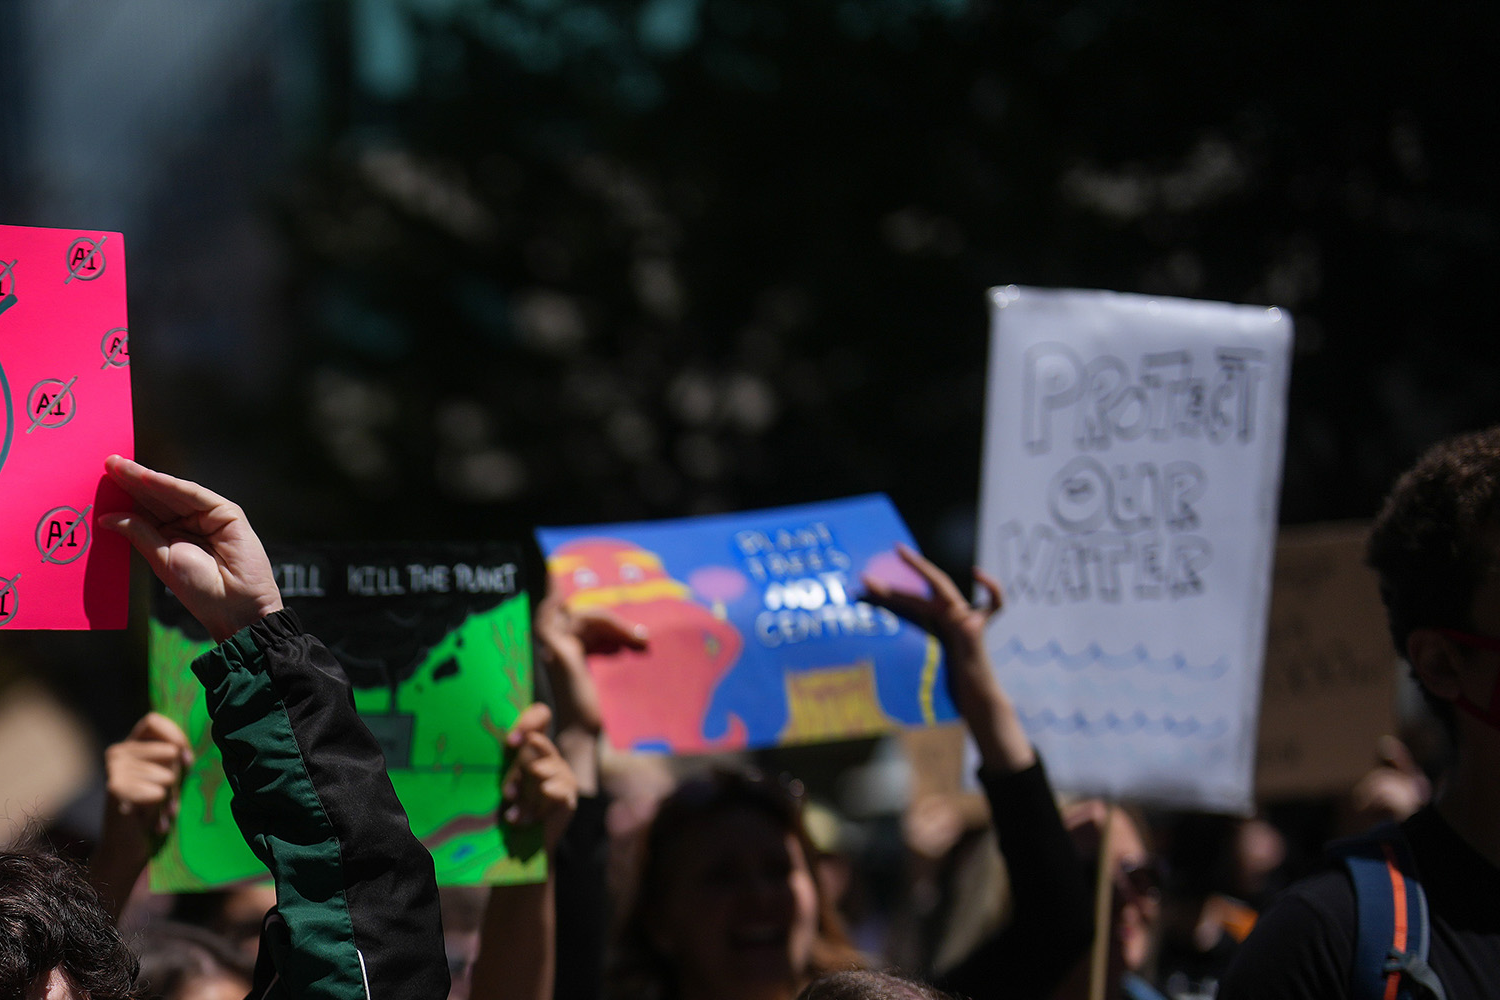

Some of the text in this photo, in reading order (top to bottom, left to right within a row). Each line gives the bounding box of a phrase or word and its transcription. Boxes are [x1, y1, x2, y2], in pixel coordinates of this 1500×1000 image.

[73, 247, 97, 270] AI
[109, 336, 130, 355] A
[36, 393, 65, 416] AI
[1022, 340, 1266, 456] PROTECT
[1048, 456, 1206, 535] OUR
[47, 520, 77, 549] AI
[1001, 520, 1213, 605] WATER
[273, 563, 326, 597] ILL
[347, 564, 405, 597] KILL
[406, 563, 450, 593] THE
